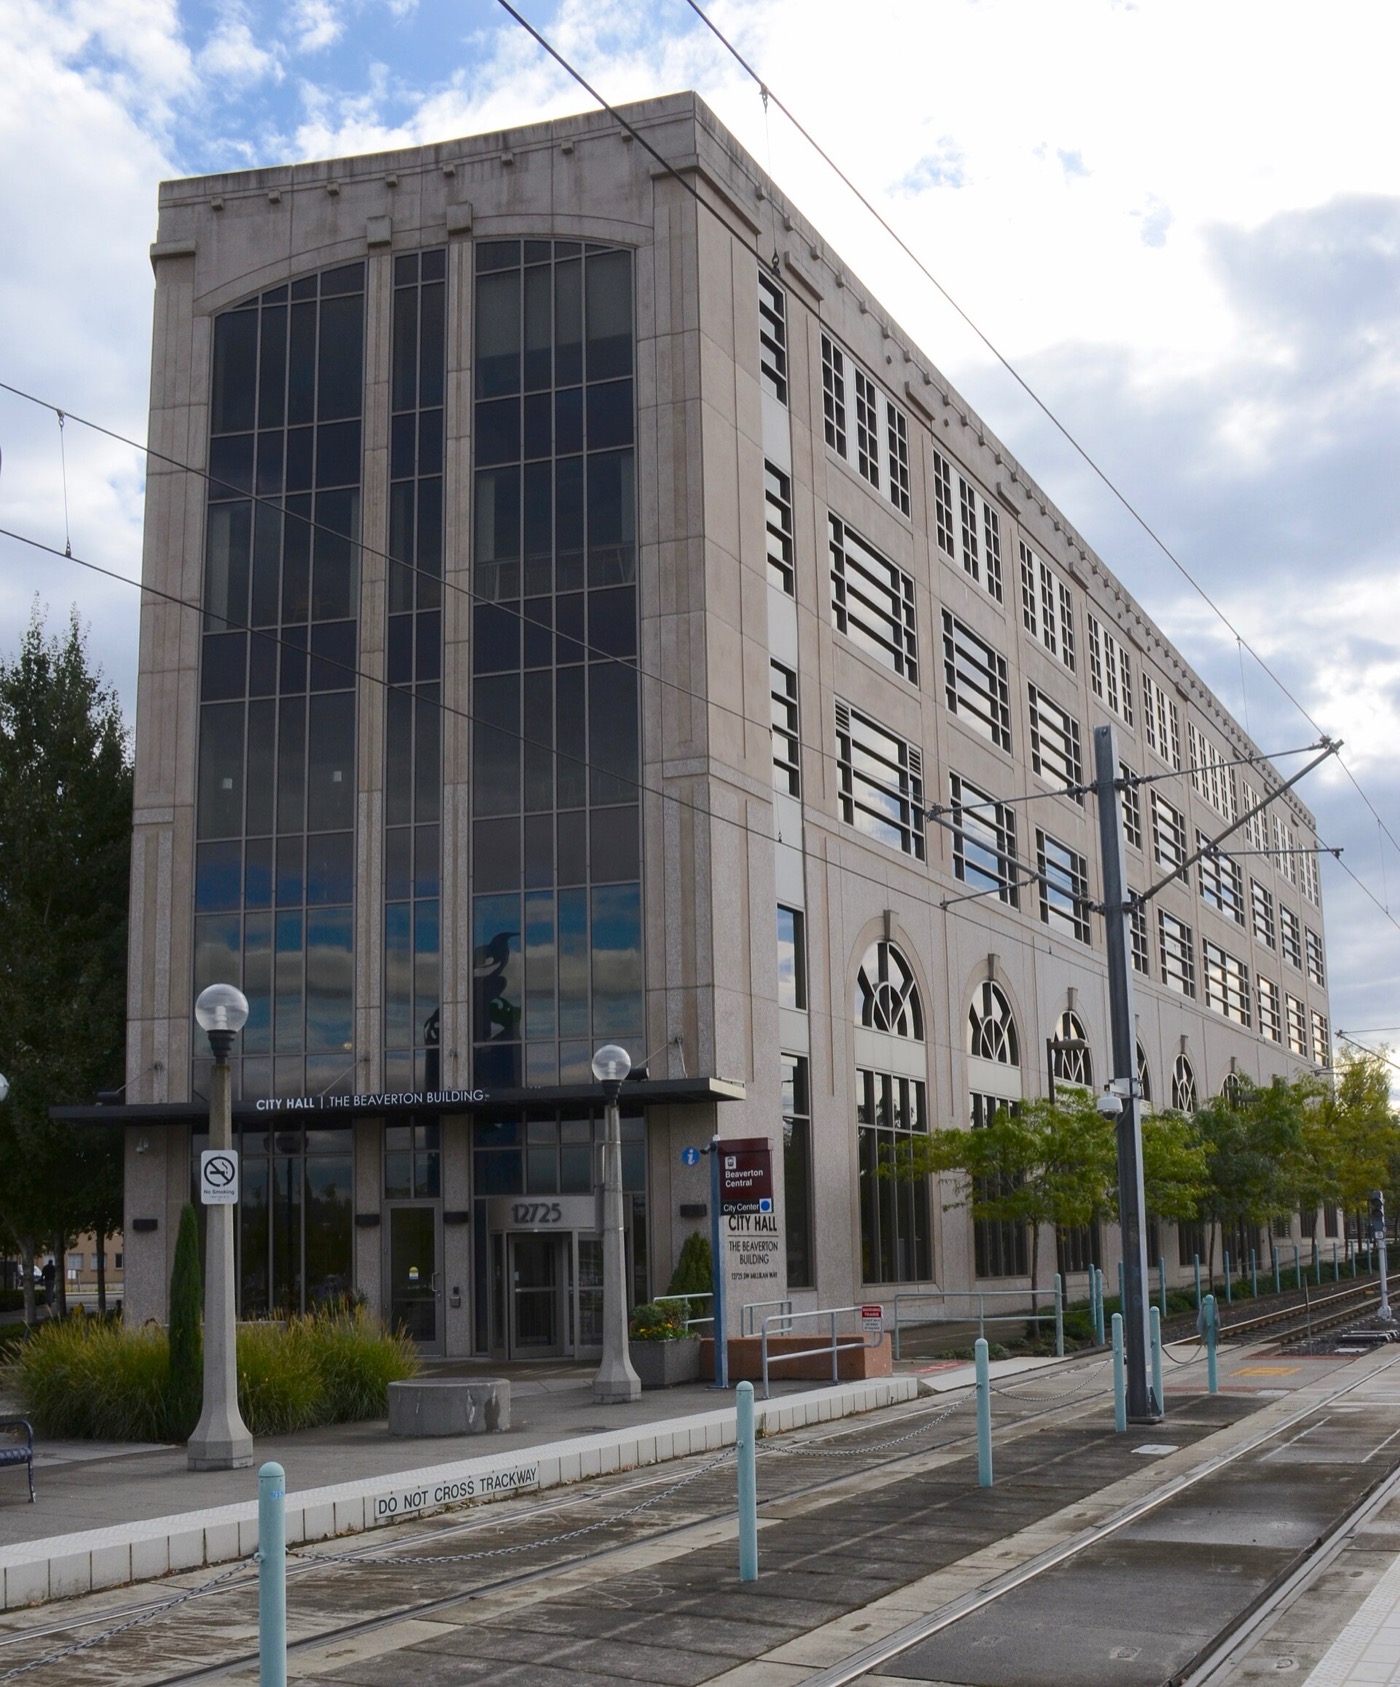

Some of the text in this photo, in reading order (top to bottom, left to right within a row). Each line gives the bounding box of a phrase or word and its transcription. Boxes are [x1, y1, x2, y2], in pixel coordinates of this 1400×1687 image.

[256, 1098, 282, 1110] CITY
[286, 1097, 315, 1109] HALL
[329, 1095, 350, 1107] THE
[353, 1092, 423, 1106] BEAVERTON
[427, 1089, 484, 1103] BUILDING
[725, 1169, 763, 1178] Beaverton
[725, 1178, 752, 1188] Central
[511, 1202, 562, 1223] 12725
[723, 1203, 759, 1213] City Center
[728, 1214, 777, 1232] CITY HALL
[729, 1240, 778, 1252] THE BEAVERTON
[739, 1253, 769, 1265] BUILDING
[378, 1467, 537, 1515] DO NOT CROSS TRACKWAY
